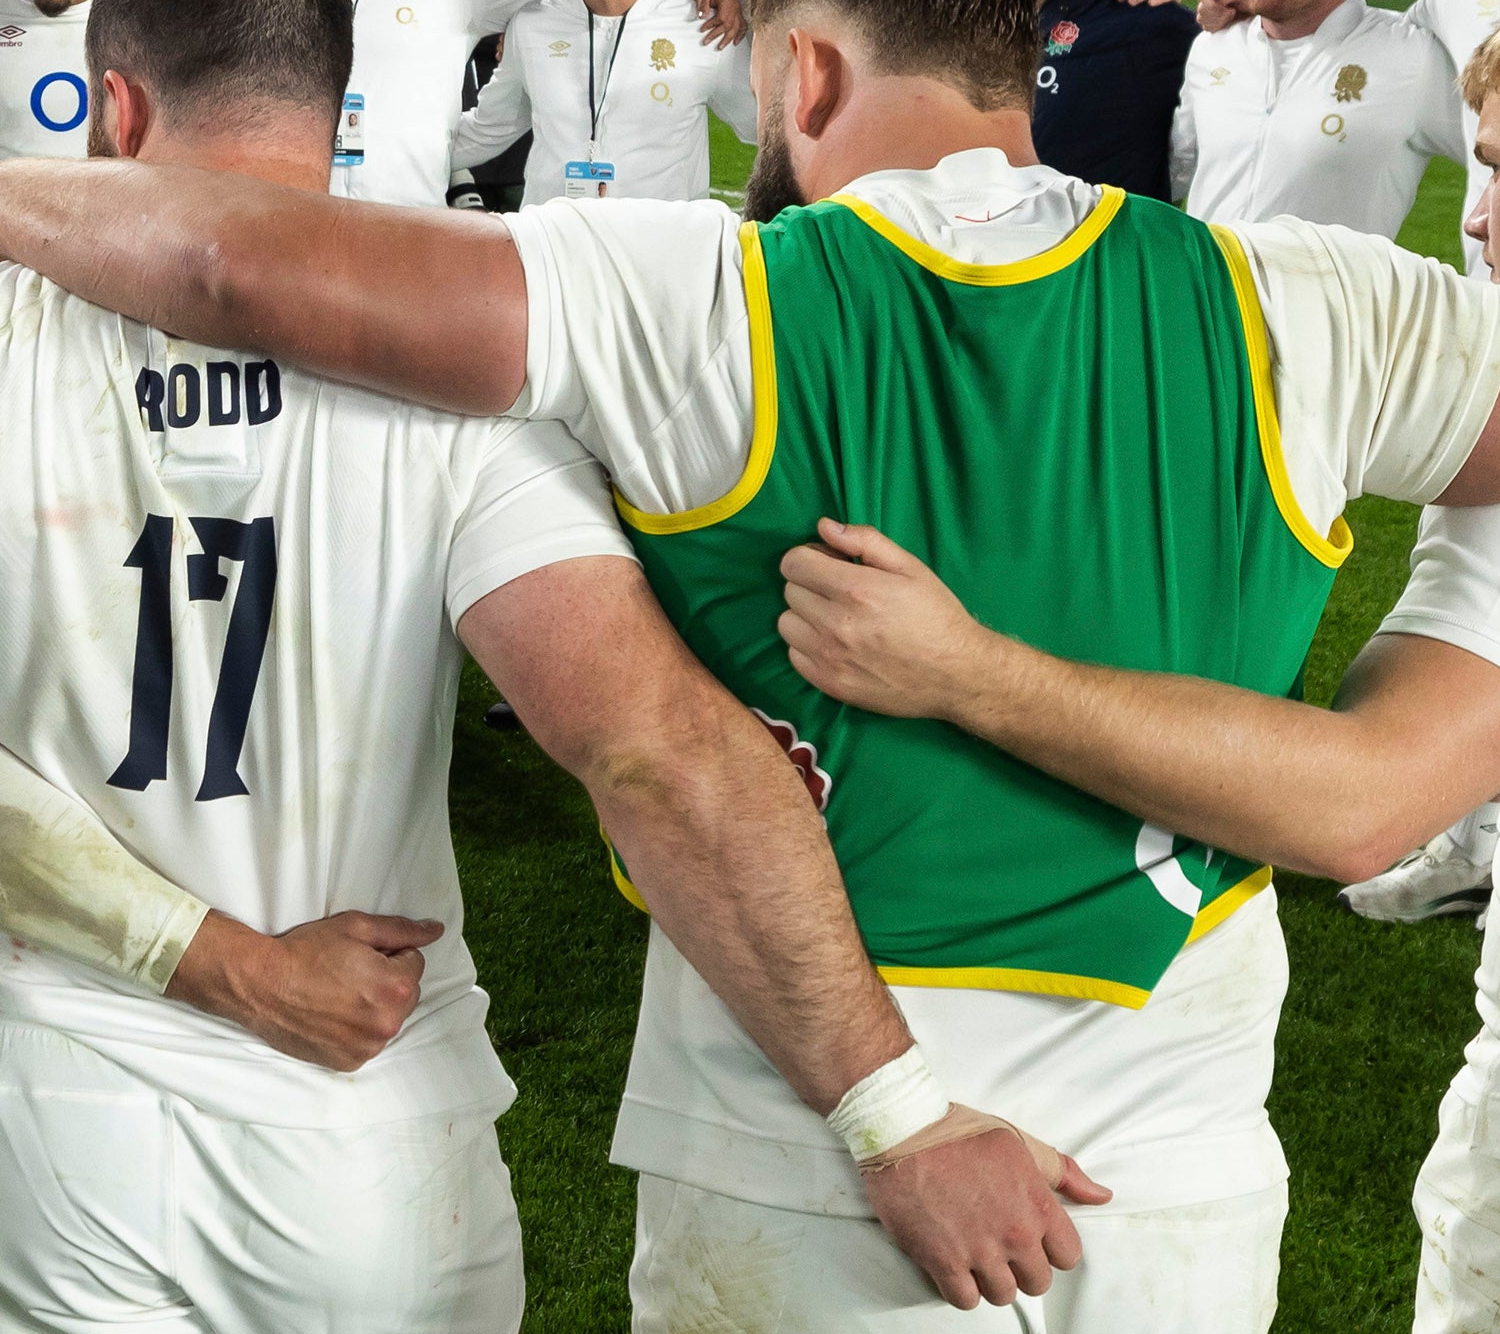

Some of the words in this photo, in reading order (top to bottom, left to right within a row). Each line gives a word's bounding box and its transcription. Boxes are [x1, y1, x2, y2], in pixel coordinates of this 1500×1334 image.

[1036, 66, 1059, 94] O2
[135, 359, 282, 432] RODD
[105, 514, 277, 802] 17
